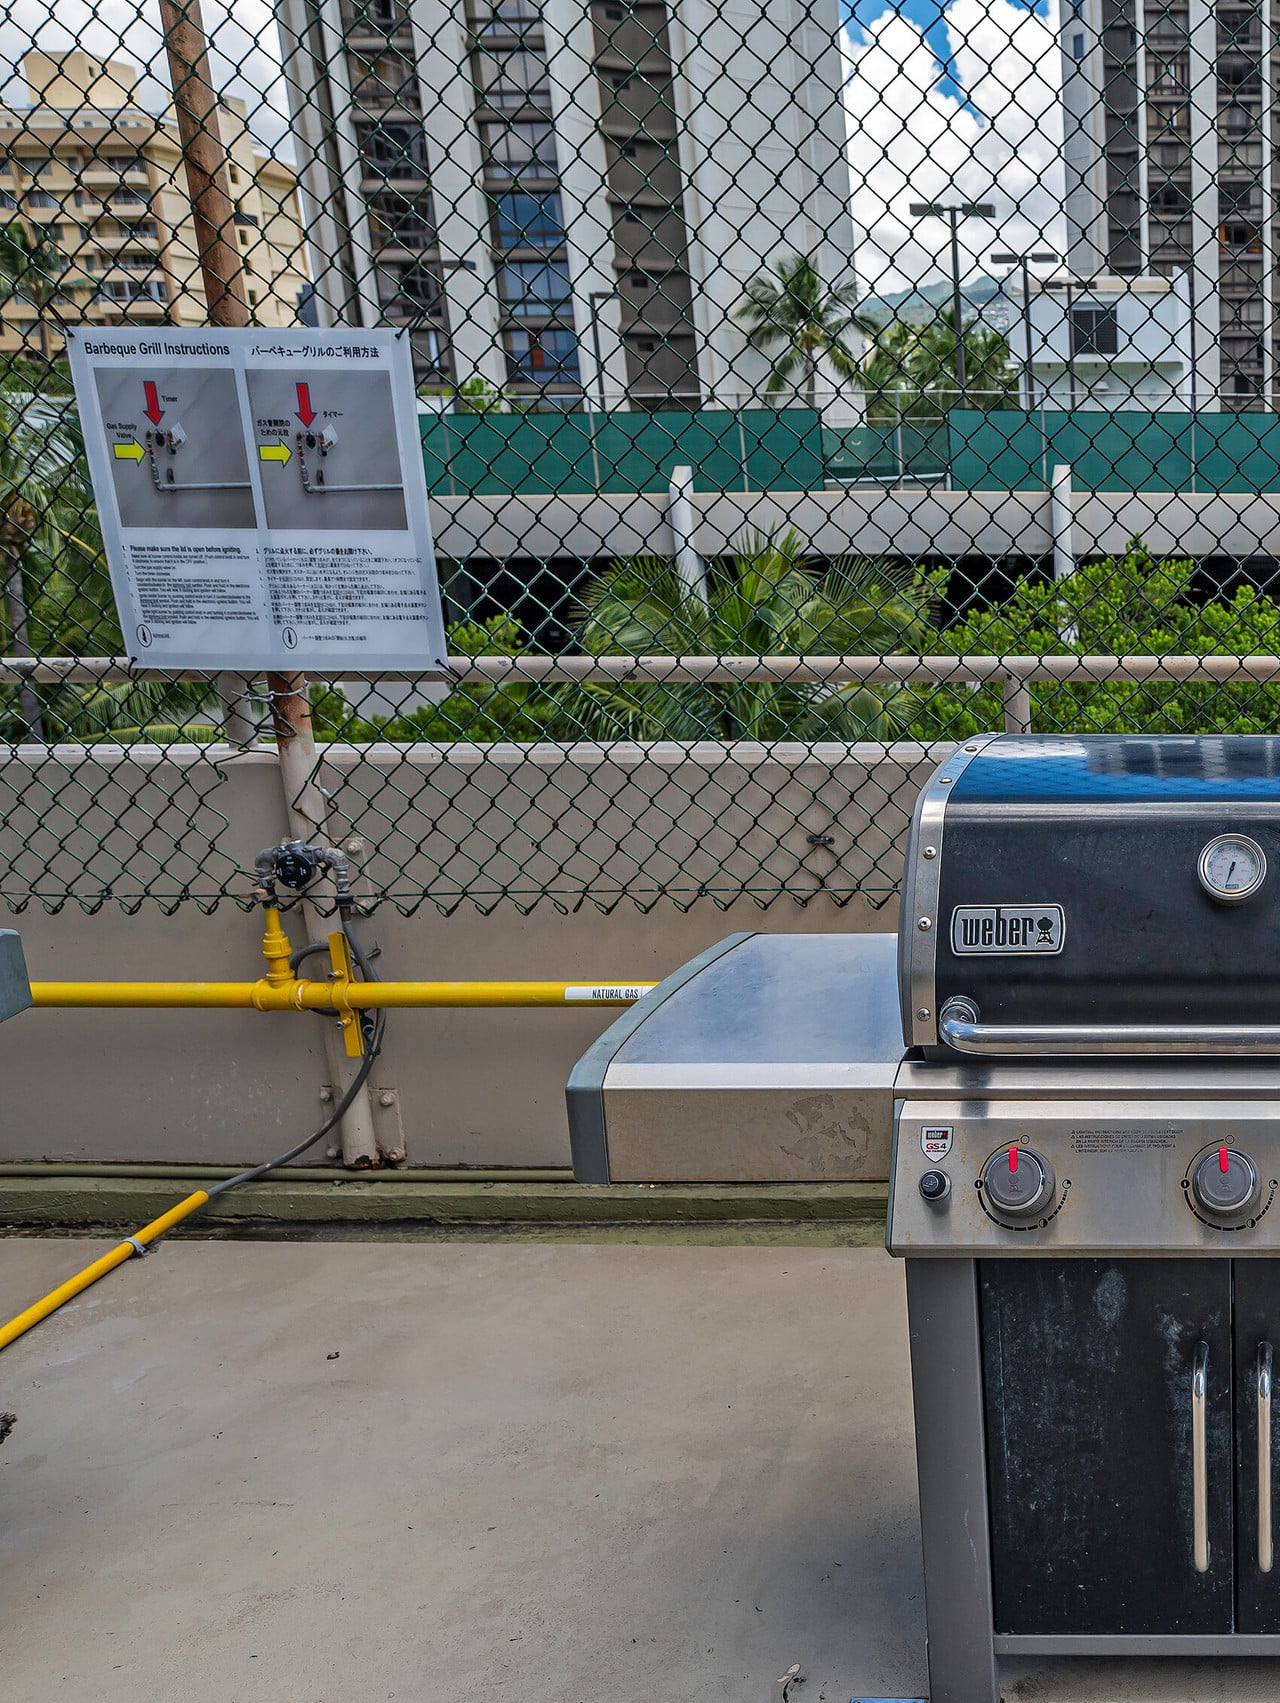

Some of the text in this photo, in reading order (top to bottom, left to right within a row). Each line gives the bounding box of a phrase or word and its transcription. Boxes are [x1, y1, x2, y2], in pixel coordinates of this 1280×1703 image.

[84, 342, 230, 357] Barbeque Grill Instructions
[118, 423, 137, 431] Supply
[961, 908, 1034, 947] weber
[592, 989, 639, 999] NATURAL GAS
